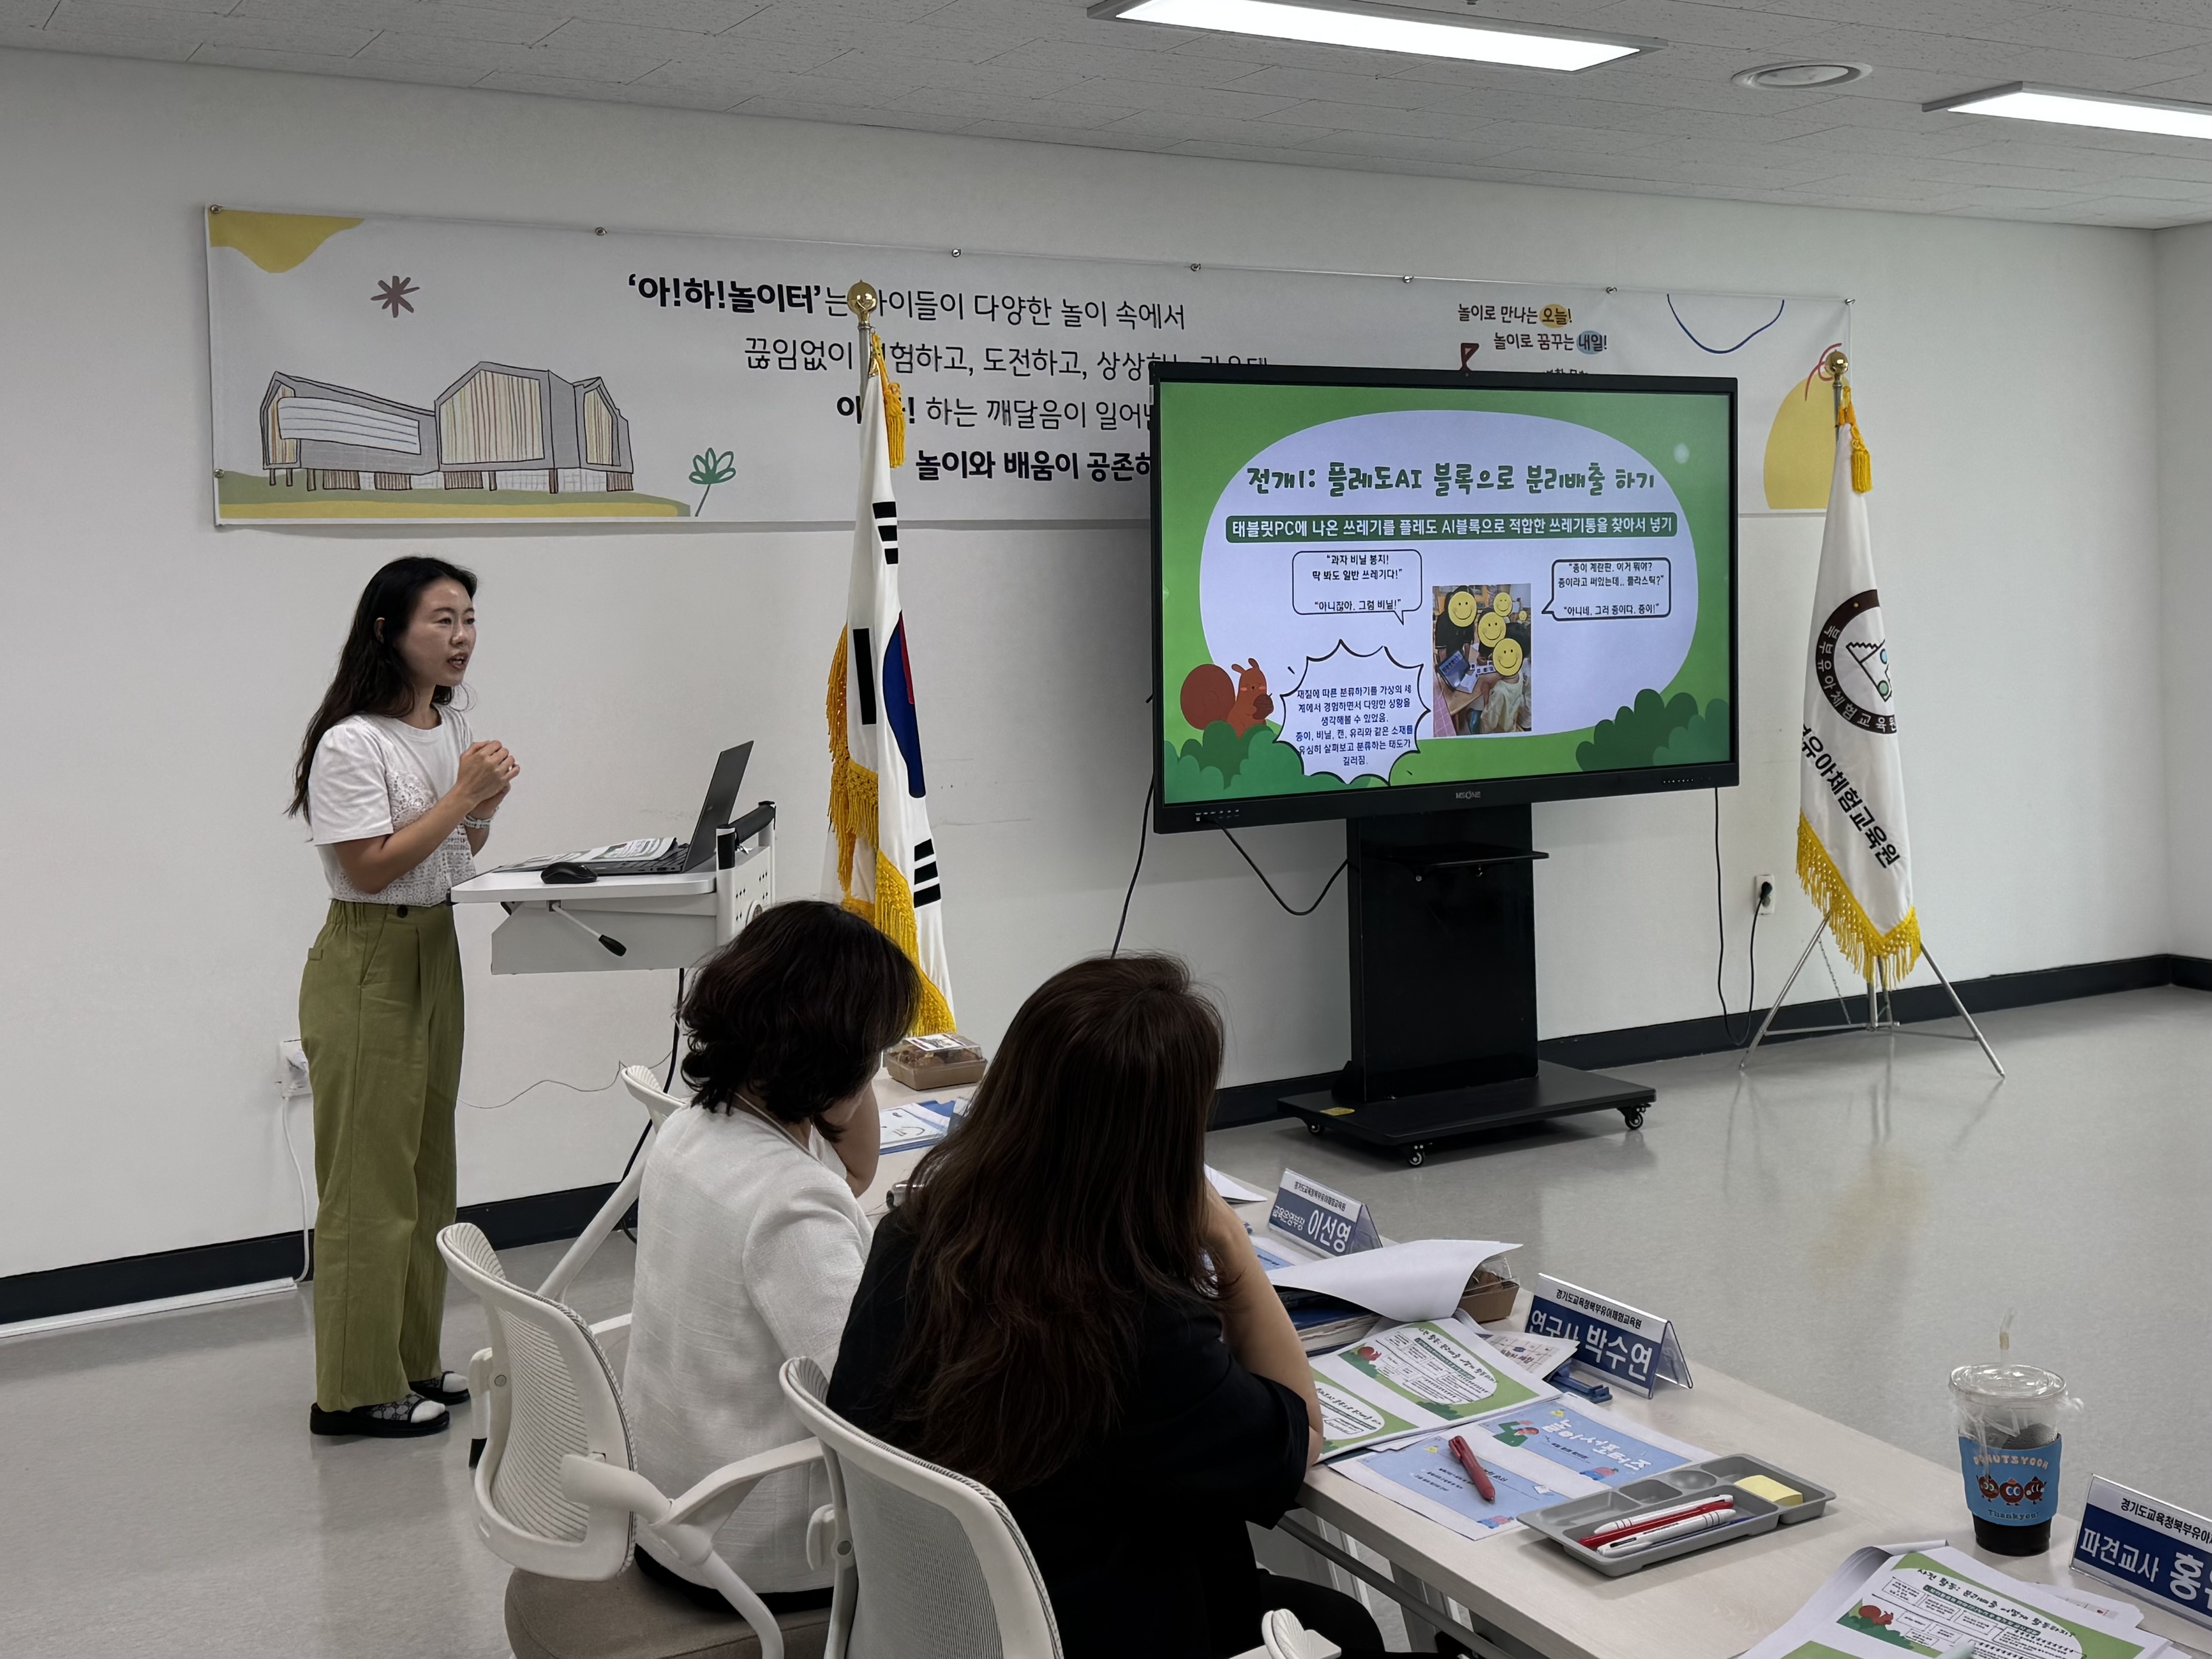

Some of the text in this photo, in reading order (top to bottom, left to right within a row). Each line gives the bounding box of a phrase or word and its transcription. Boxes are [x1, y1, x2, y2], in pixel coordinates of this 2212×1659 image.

[974, 294, 1052, 326] 다양한
[1061, 299, 1107, 330] 놀이
[1115, 301, 1185, 330] 속에서
[1457, 303, 1573, 325] 놀이로 만나는 오늘!
[1494, 332, 1607, 352] 놀이로 꿈꾸는 내일!
[744, 337, 1190, 381] 끊임없이 험하고, 도전하고, 상상
[925, 397, 978, 427] 하는
[986, 399, 1086, 430] 깨달음이
[915, 450, 996, 481] 놀이와
[1004, 450, 1079, 480] 배움이
[1328, 462, 1423, 497] 플레도AI
[1434, 462, 1514, 497] 블록으로
[1526, 462, 1606, 497] 분리배출
[1615, 468, 1654, 489] 하기
[1232, 517, 1672, 537] 태블릿PC에 나온 쓰레기를 플레도 AI블록으로 적합한 쓰레기통을 찾아서 넣기
[1327, 554, 1389, 565] “과자 비닐 봉지!
[1617, 562, 1631, 572] 이거
[1324, 571, 1340, 581] 봐도
[1343, 570, 1359, 581] 일반
[1362, 568, 1403, 580] 쓰레기다!”
[1558, 577, 1587, 588] 종이라고
[1358, 600, 1375, 611] 그럼
[1377, 599, 1402, 610] 비닐!”
[1340, 686, 1377, 698] 분류하기를
[1324, 701, 1361, 712] 경험하면서
[1354, 714, 1361, 724] 수
[1349, 728, 1372, 738] 유리와
[1299, 745, 1322, 755] 유심히
[1357, 741, 1386, 751] 분류하는
[1307, 1209, 1352, 1253] 이선영
[1585, 1324, 1653, 1382] 박수연
[2121, 1497, 2212, 1544] 경기도교육청북부유아
[2080, 1527, 2159, 1582] 파견교사
